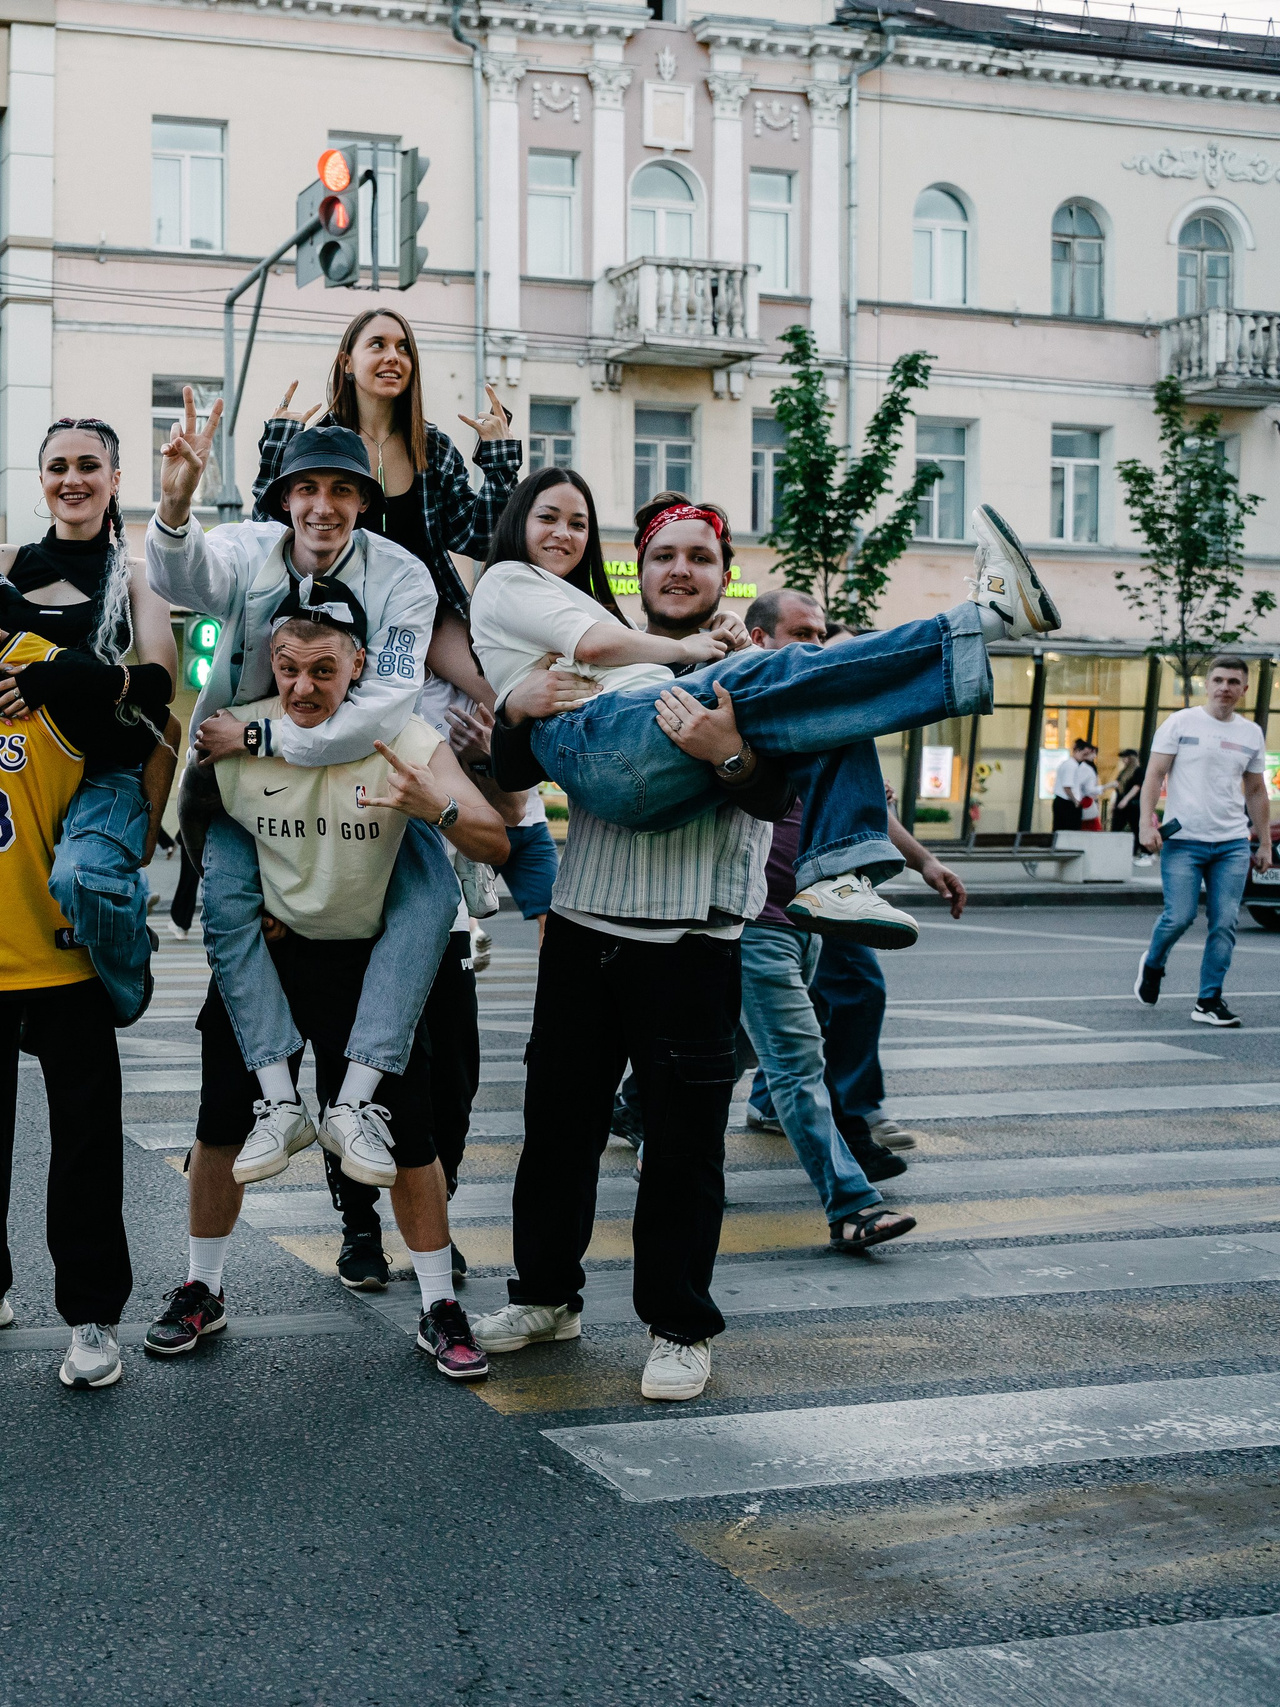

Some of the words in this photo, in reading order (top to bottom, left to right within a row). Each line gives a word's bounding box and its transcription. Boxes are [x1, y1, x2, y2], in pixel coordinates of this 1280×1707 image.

[383, 625, 416, 654] 19
[376, 651, 416, 679] 86
[257, 816, 307, 838] FEAR
[341, 821, 381, 841] GOD
